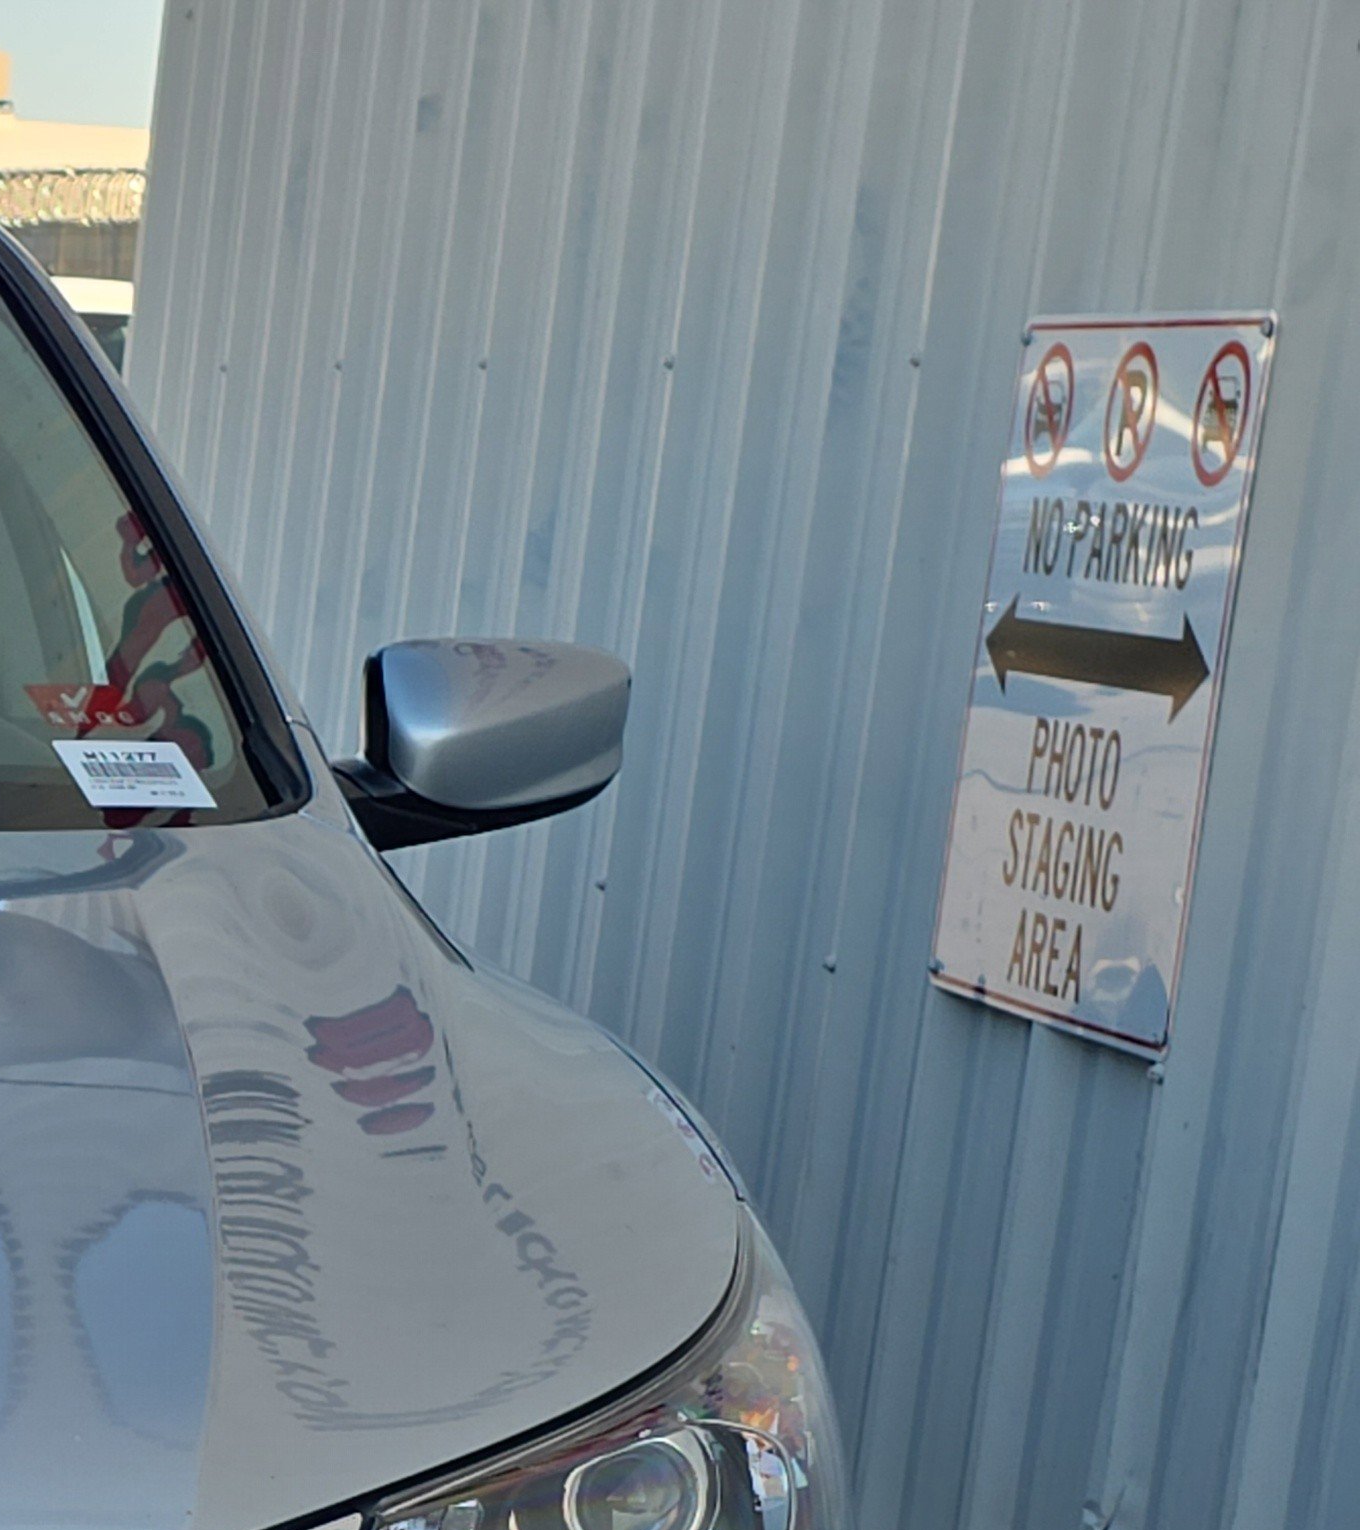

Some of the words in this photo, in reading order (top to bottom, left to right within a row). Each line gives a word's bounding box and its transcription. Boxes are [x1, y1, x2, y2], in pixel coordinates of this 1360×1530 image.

[1023, 496, 1064, 576] NO
[1066, 500, 1200, 590] PARKING
[1026, 716, 1121, 811] PHOTO
[1002, 808, 1123, 912] STAGING
[1006, 907, 1083, 1004] AREA
